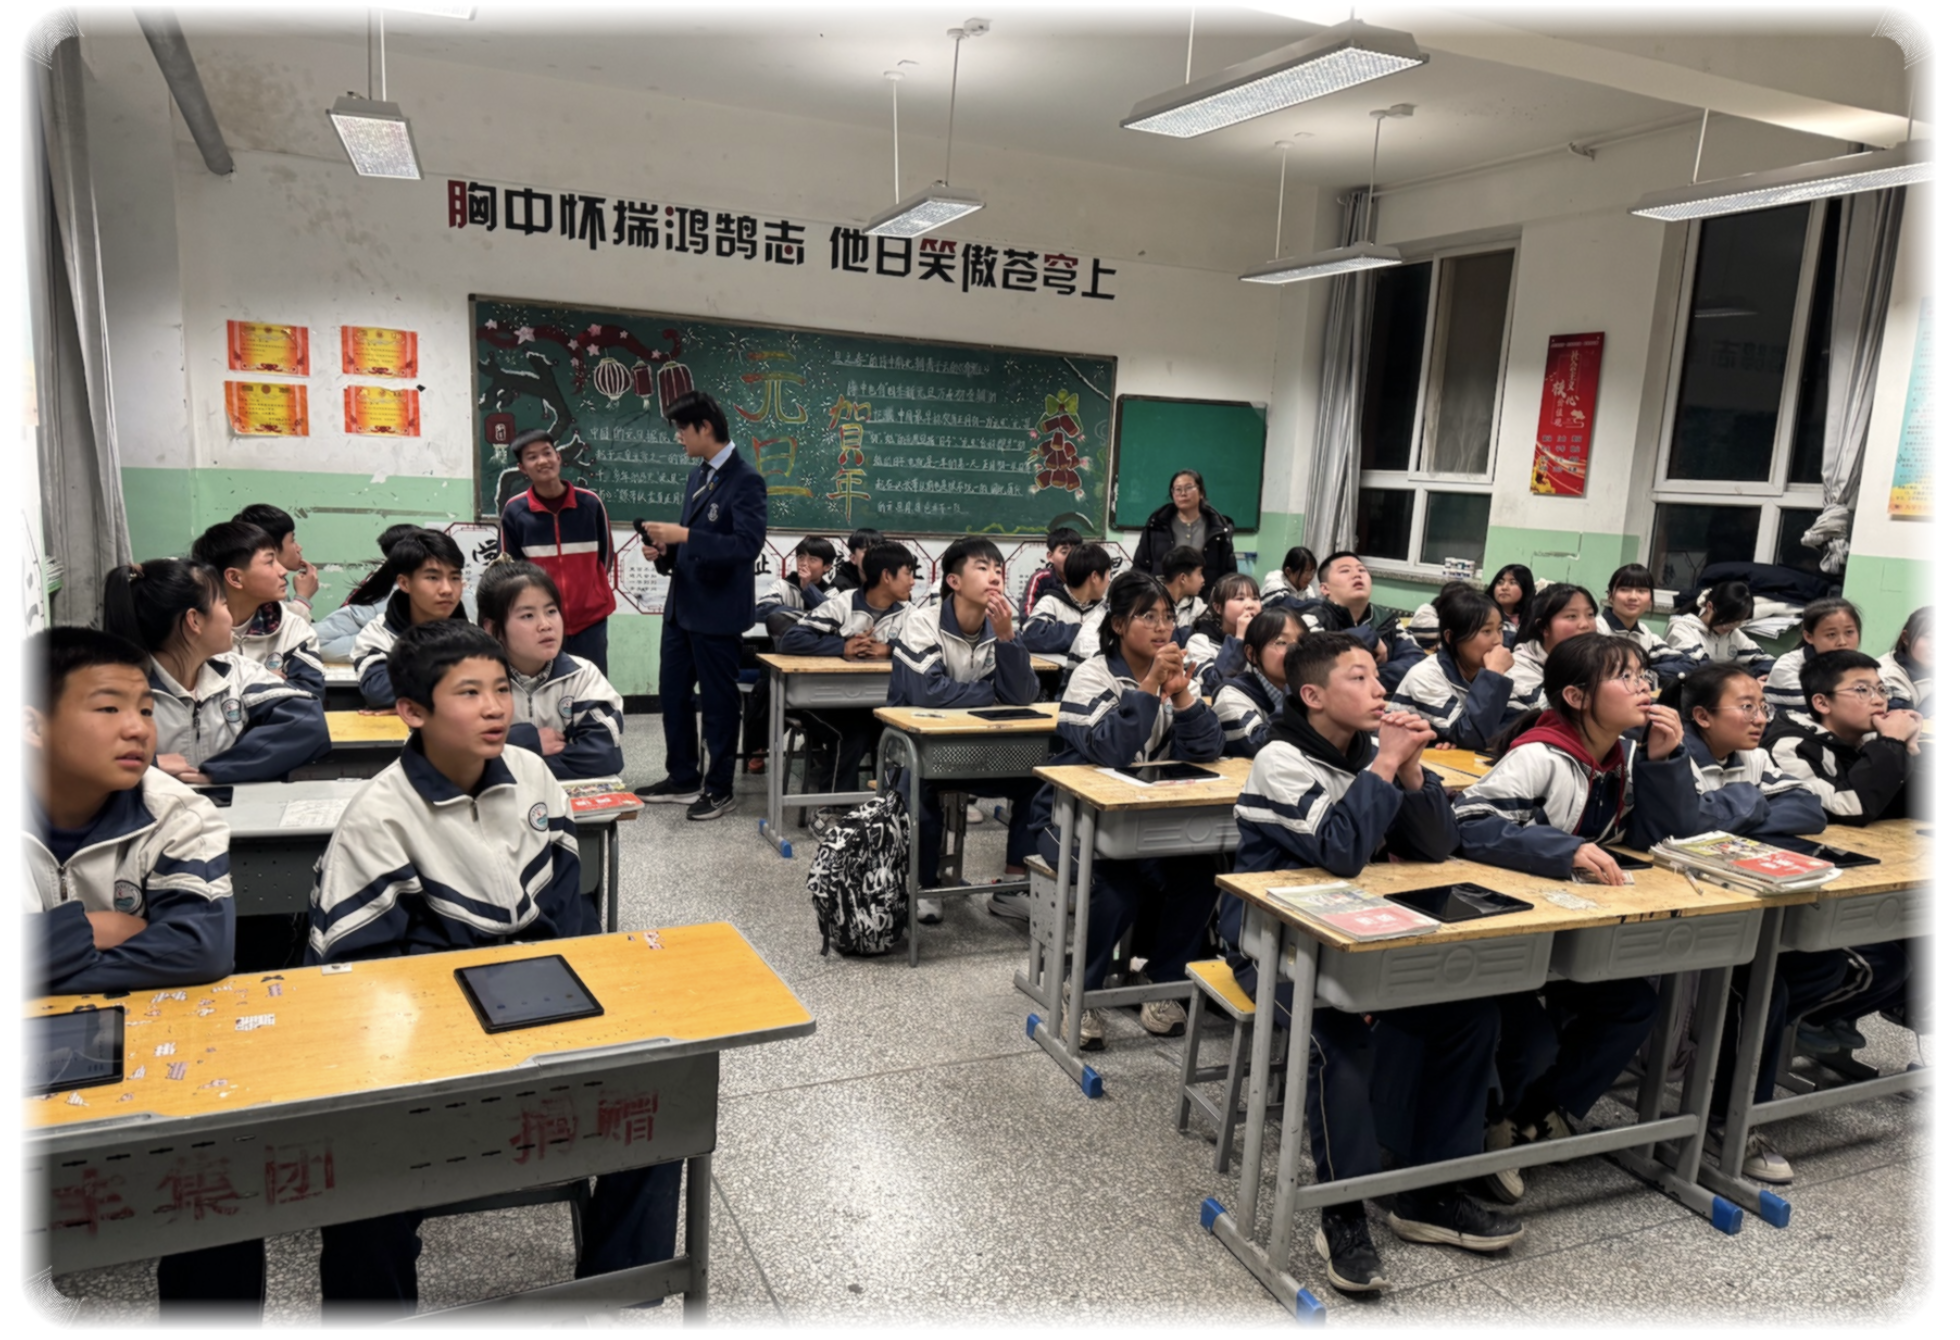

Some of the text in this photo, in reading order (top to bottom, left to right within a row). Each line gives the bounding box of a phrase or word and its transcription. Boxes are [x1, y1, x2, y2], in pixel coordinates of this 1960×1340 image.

[446, 179, 1117, 300] 胸中怀揣鸿鹄志 他日笑傲苍穹上
[732, 350, 814, 498] 元旦
